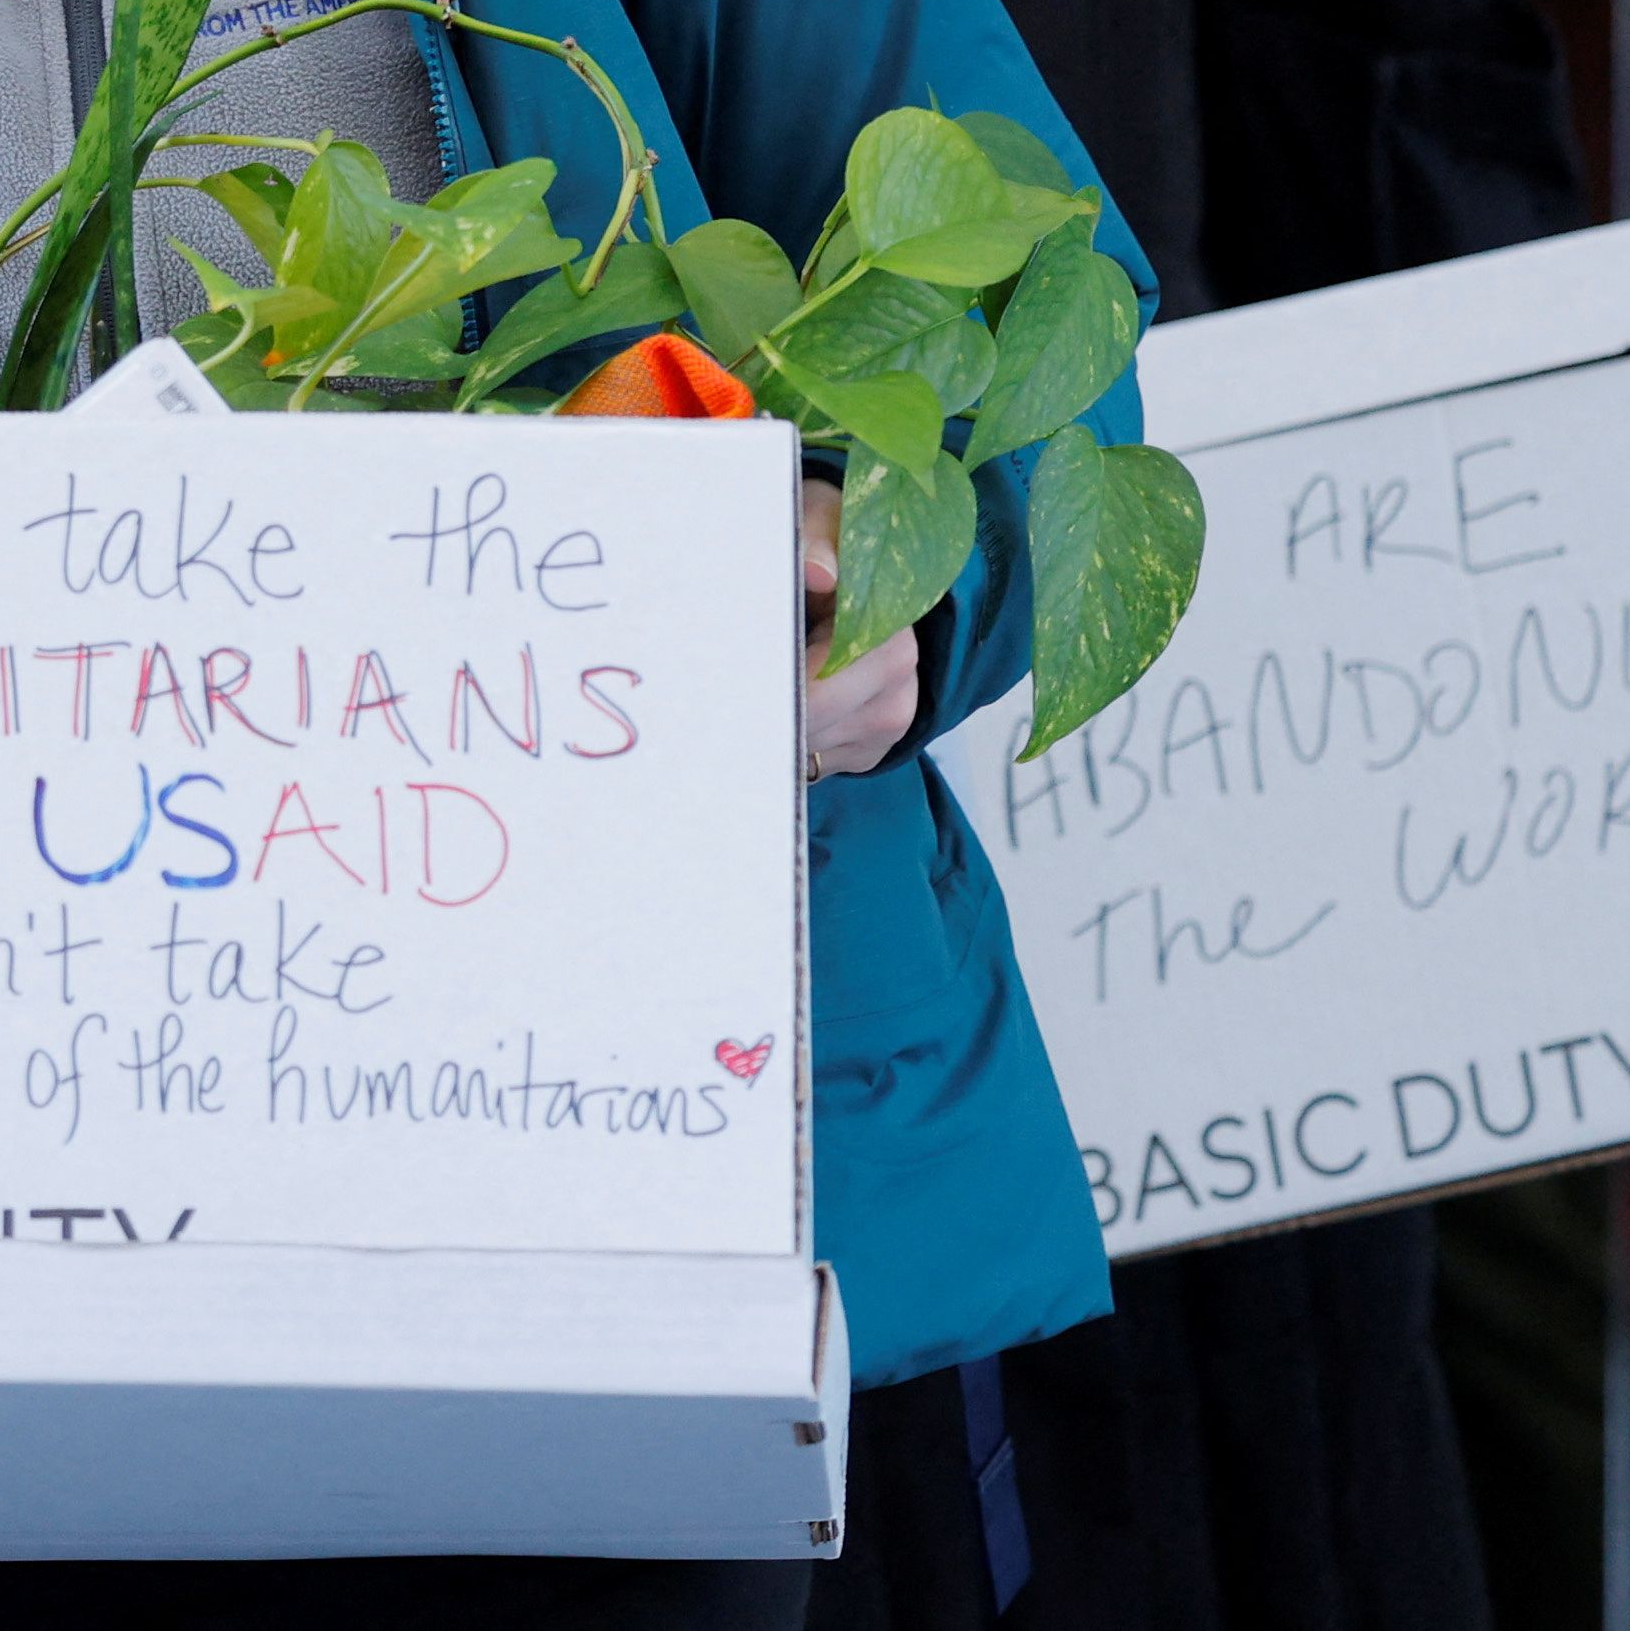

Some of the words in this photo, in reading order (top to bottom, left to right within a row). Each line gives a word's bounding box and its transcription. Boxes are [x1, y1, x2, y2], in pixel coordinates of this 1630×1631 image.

[23, 472, 307, 604] take
[389, 472, 613, 614] the
[1282, 436, 1568, 580] ARE
[33, 762, 513, 908] USAID
[149, 898, 395, 1014] take
[24, 1013, 107, 1143] of
[118, 1013, 224, 1115] the
[265, 1006, 732, 1140] humanitarians
[1079, 1090, 1368, 1228] BASIC
